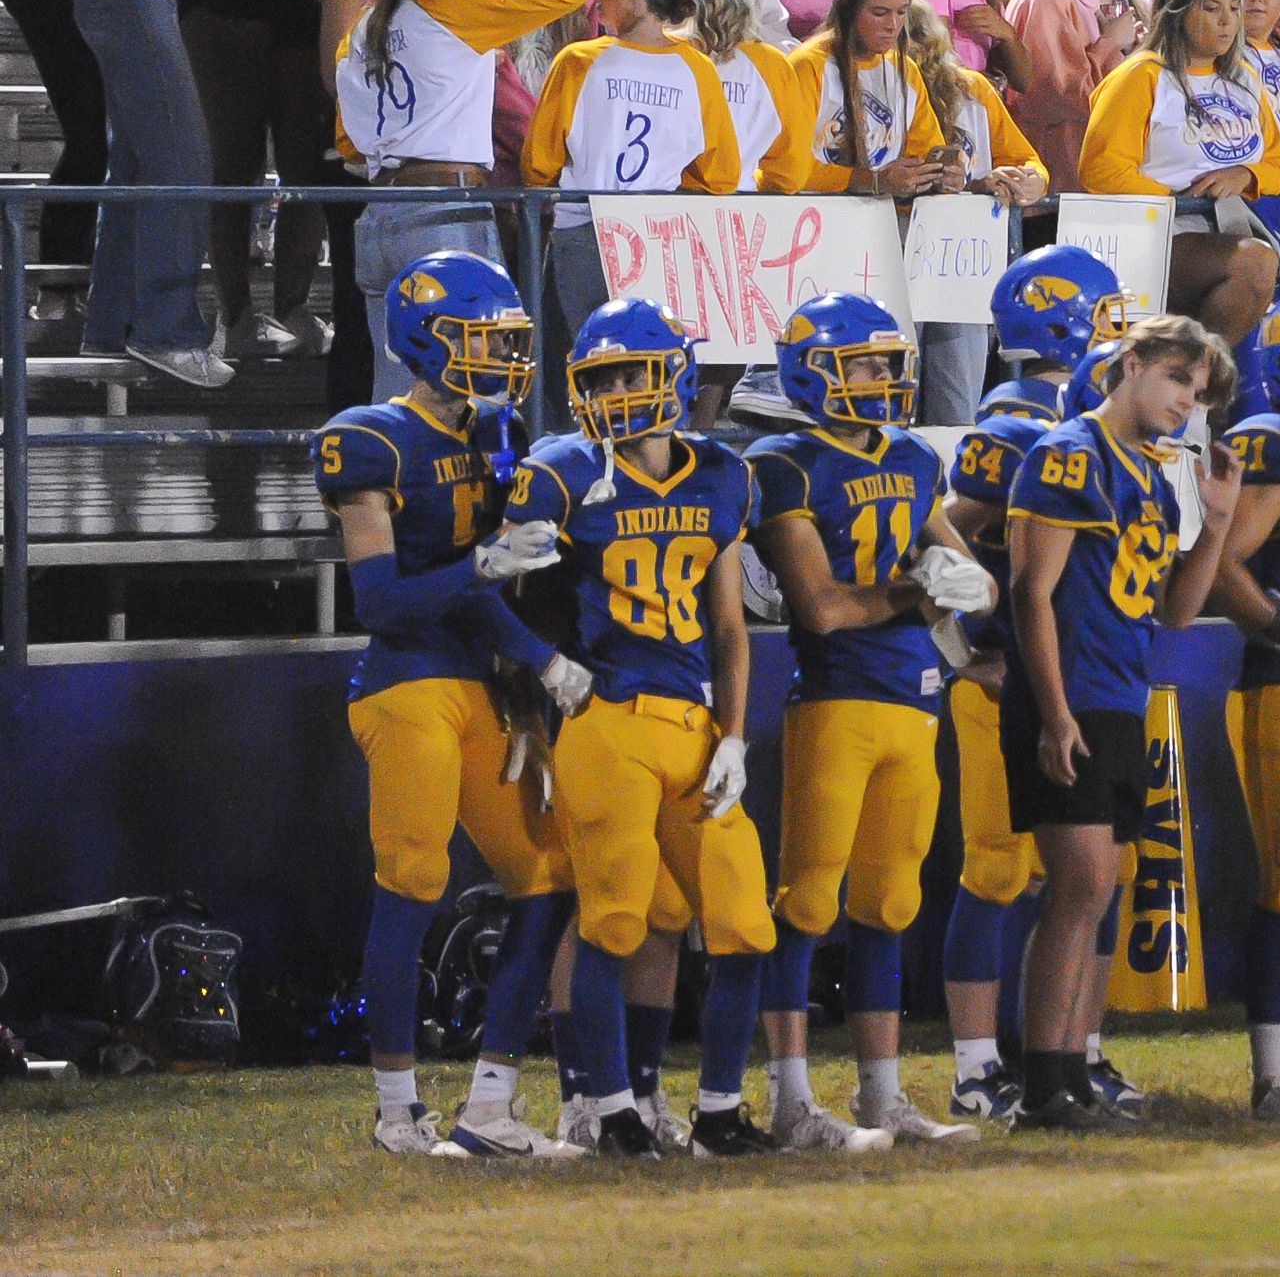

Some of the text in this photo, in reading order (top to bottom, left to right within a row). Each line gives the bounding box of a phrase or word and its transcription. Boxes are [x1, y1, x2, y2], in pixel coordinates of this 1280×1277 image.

[605, 77, 684, 111] BUCHHEIT
[615, 110, 651, 184] 3
[910, 223, 992, 282] BRIGID
[597, 208, 784, 347] PINK
[321, 435, 343, 474] 5
[960, 438, 1006, 485] 64
[1040, 450, 1088, 491] 69
[843, 473, 917, 507] INDIANS
[614, 505, 710, 536] INDIANS
[851, 501, 912, 586] 11
[602, 535, 718, 645] 88
